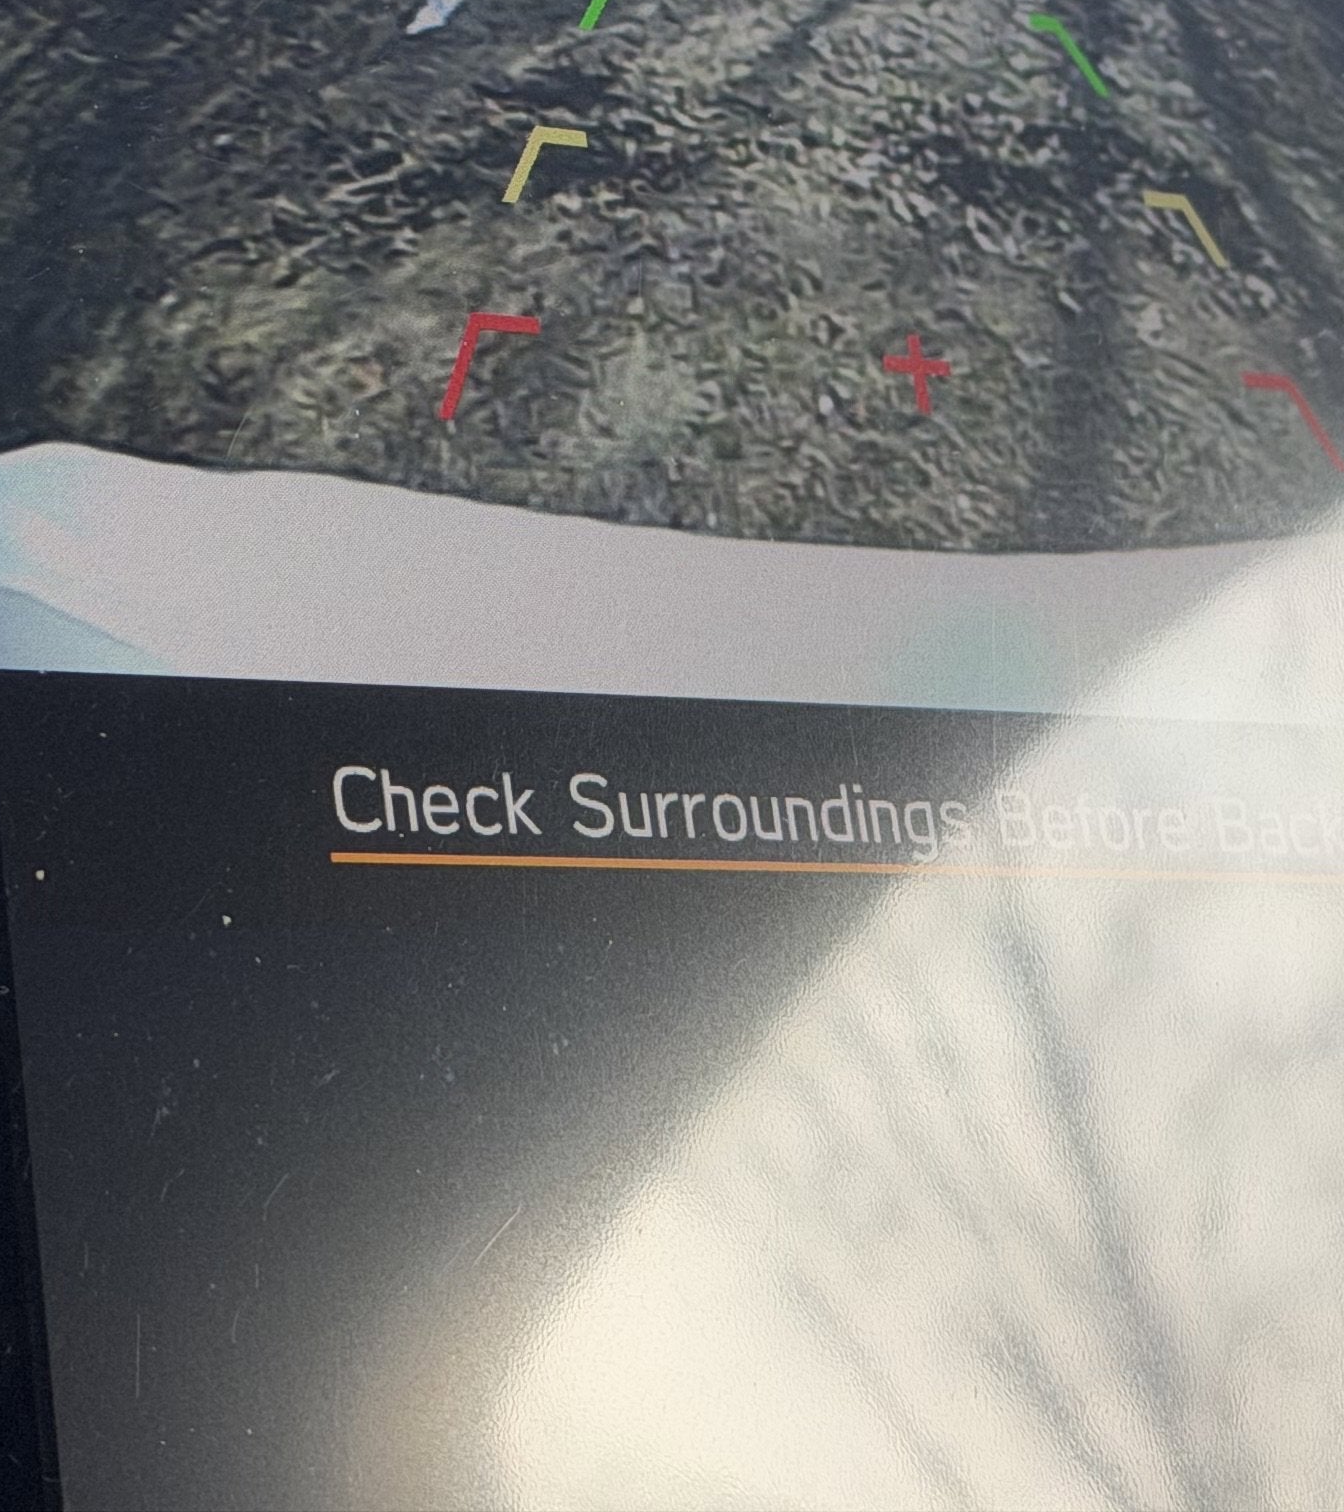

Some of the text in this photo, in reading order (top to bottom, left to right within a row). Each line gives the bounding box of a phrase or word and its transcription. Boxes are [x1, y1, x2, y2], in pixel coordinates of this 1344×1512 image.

[332, 766, 542, 837] Check
[568, 772, 971, 863] Surroundings
[994, 787, 1192, 853] Before
